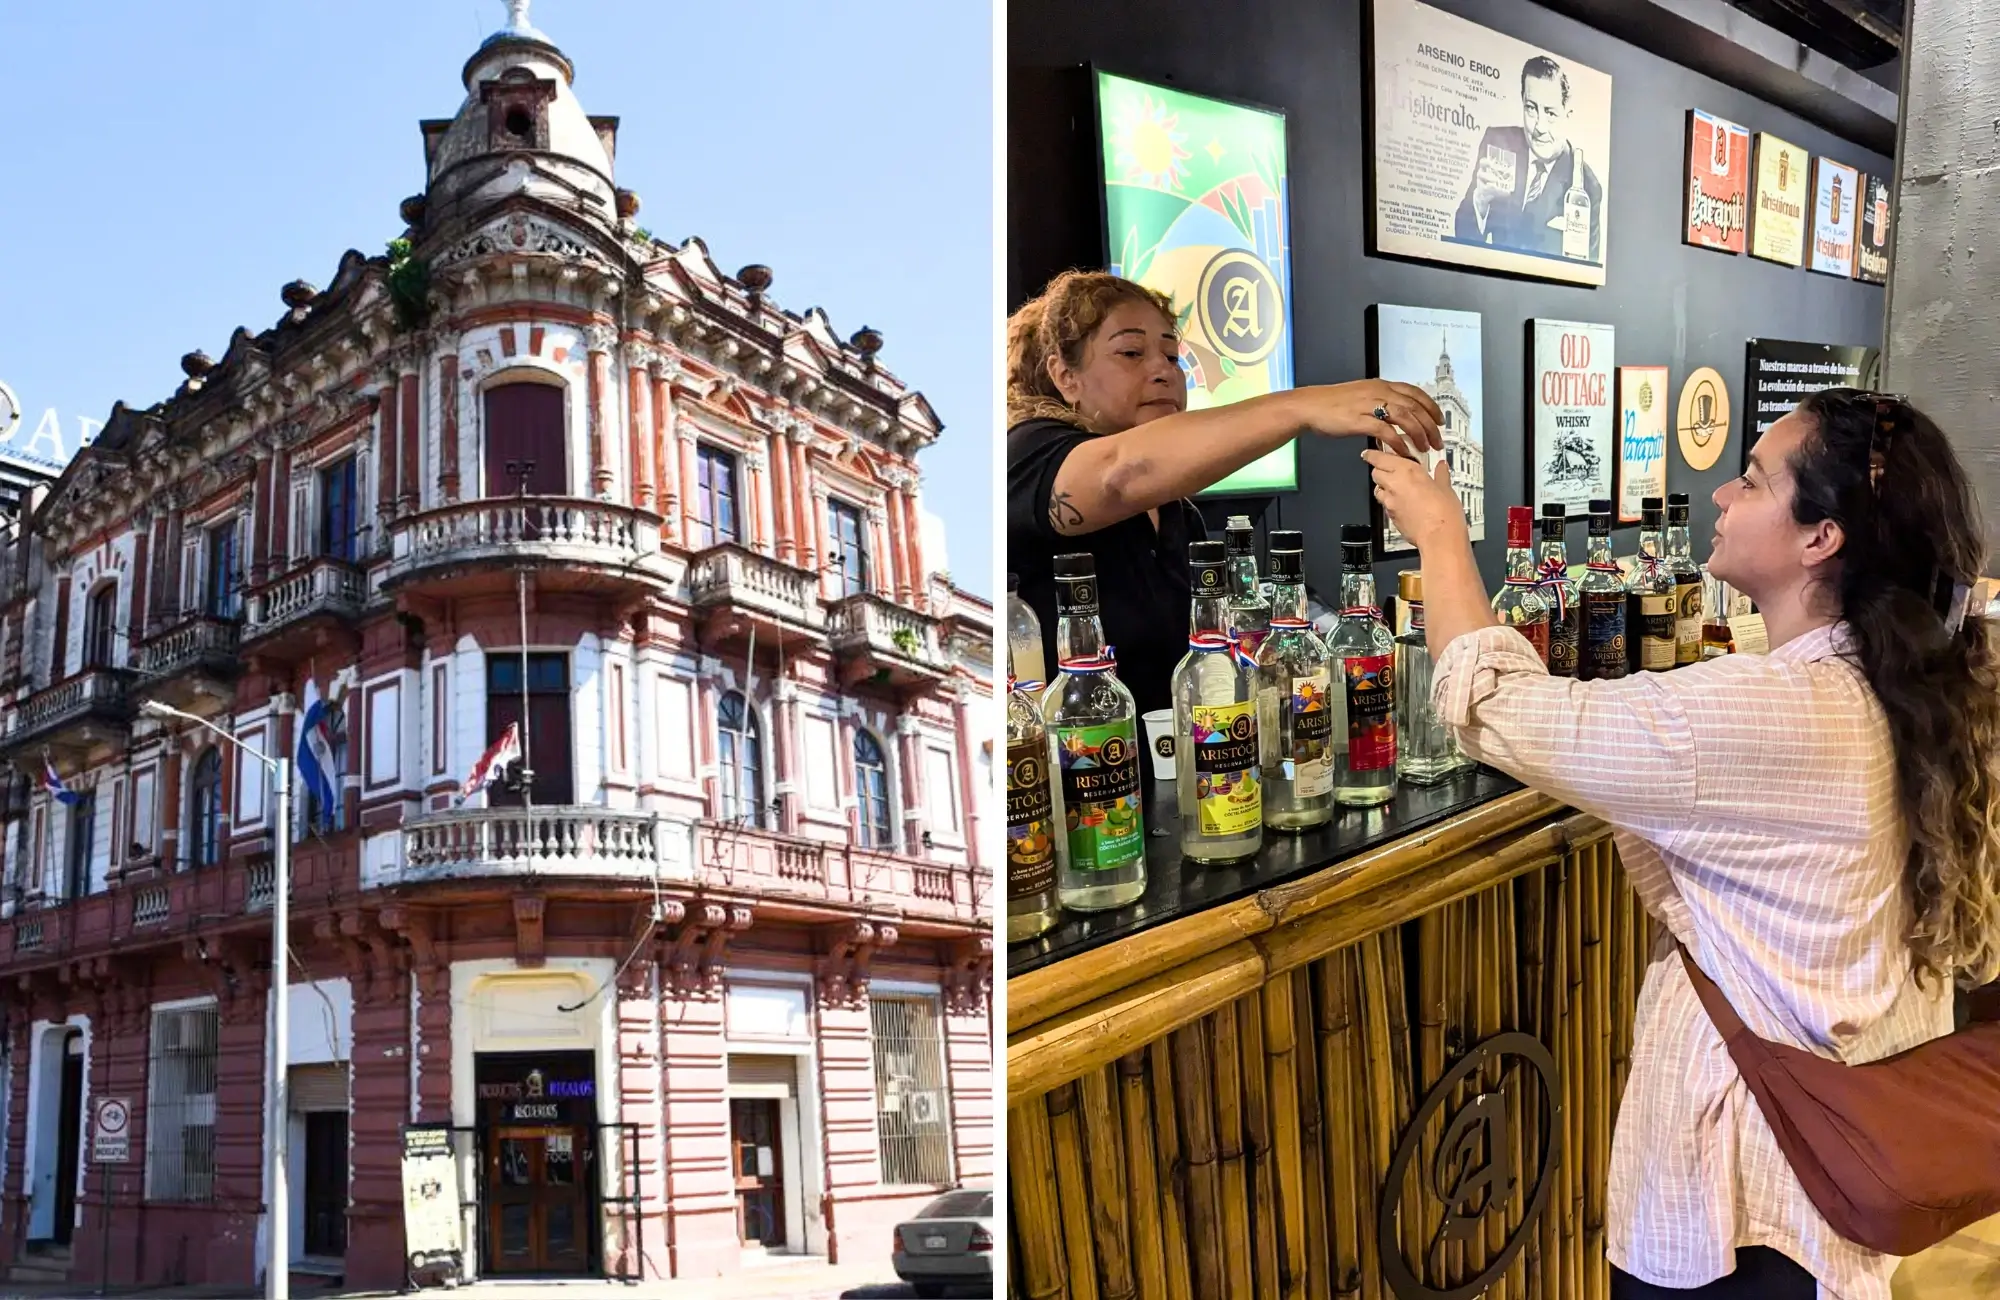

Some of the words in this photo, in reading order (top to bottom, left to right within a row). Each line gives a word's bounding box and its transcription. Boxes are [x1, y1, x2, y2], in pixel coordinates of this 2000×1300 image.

[1417, 43, 1465, 68] ARSENIO
[1469, 60, 1501, 80] ERICO
[1389, 207, 1410, 216] CARLOS
[1560, 333, 1590, 369] OLD
[1759, 359, 1787, 372] Nuestras
[1787, 363, 1808, 373] marcas
[1809, 365, 1813, 373] a
[1813, 362, 1830, 374] través
[1830, 363, 1837, 375] de
[1837, 363, 1846, 375] los
[1542, 371, 1607, 407] COTTAGE
[1758, 379, 1767, 391] La
[1768, 379, 1796, 392] evolución
[1797, 380, 1805, 392] de
[1757, 400, 1769, 412] Las
[1556, 415, 1591, 428] WHISKY
[1214, 760, 1242, 769] RESERVA
[1083, 788, 1116, 798] RESERVA
